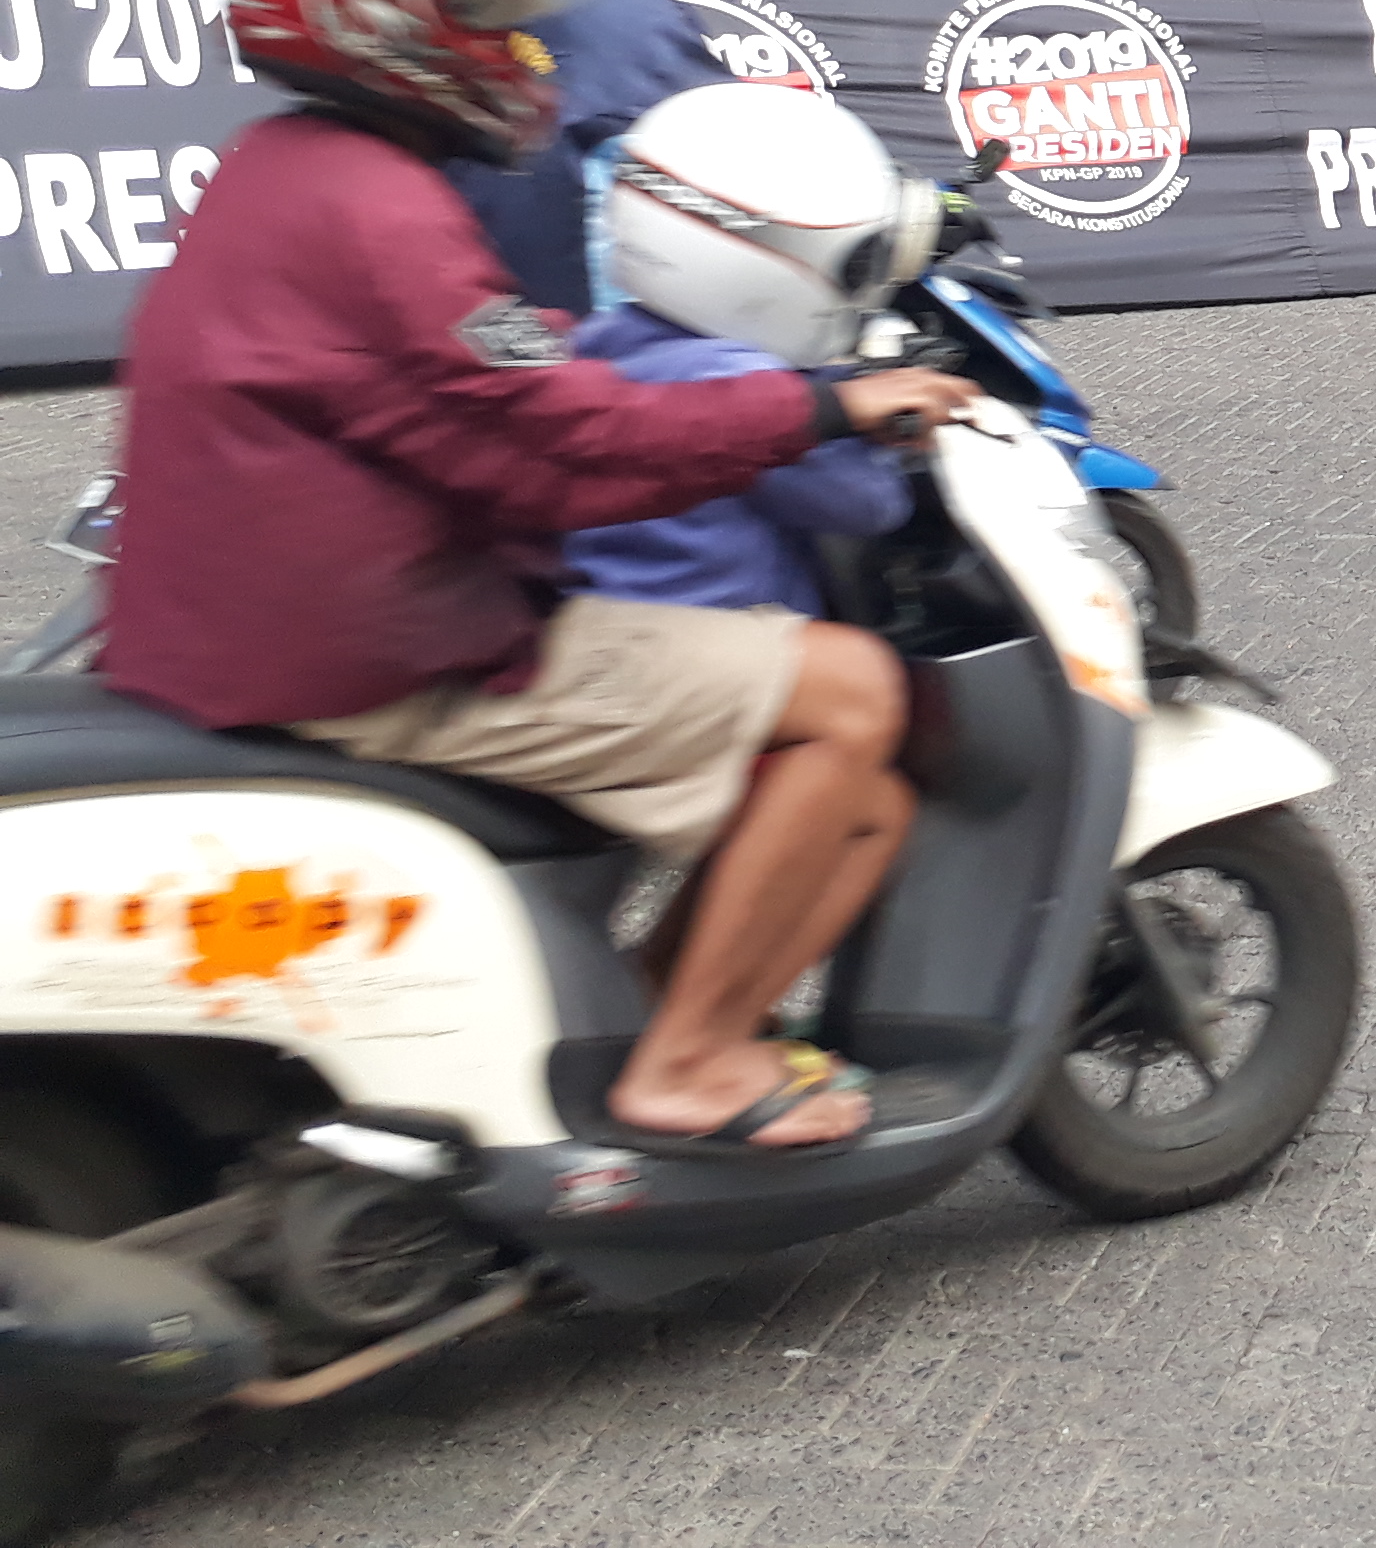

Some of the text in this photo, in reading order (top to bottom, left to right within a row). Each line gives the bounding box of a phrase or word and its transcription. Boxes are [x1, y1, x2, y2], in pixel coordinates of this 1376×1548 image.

[923, 9, 971, 93] KOMITE
[970, 29, 1148, 86] #2019
[971, 78, 1171, 136] GANTI
[983, 125, 1183, 163] RESIDEN
[1040, 166, 1143, 182] KPN-GP 2019
[1007, 174, 1191, 232] SECARA KONSTITUSIONAL
